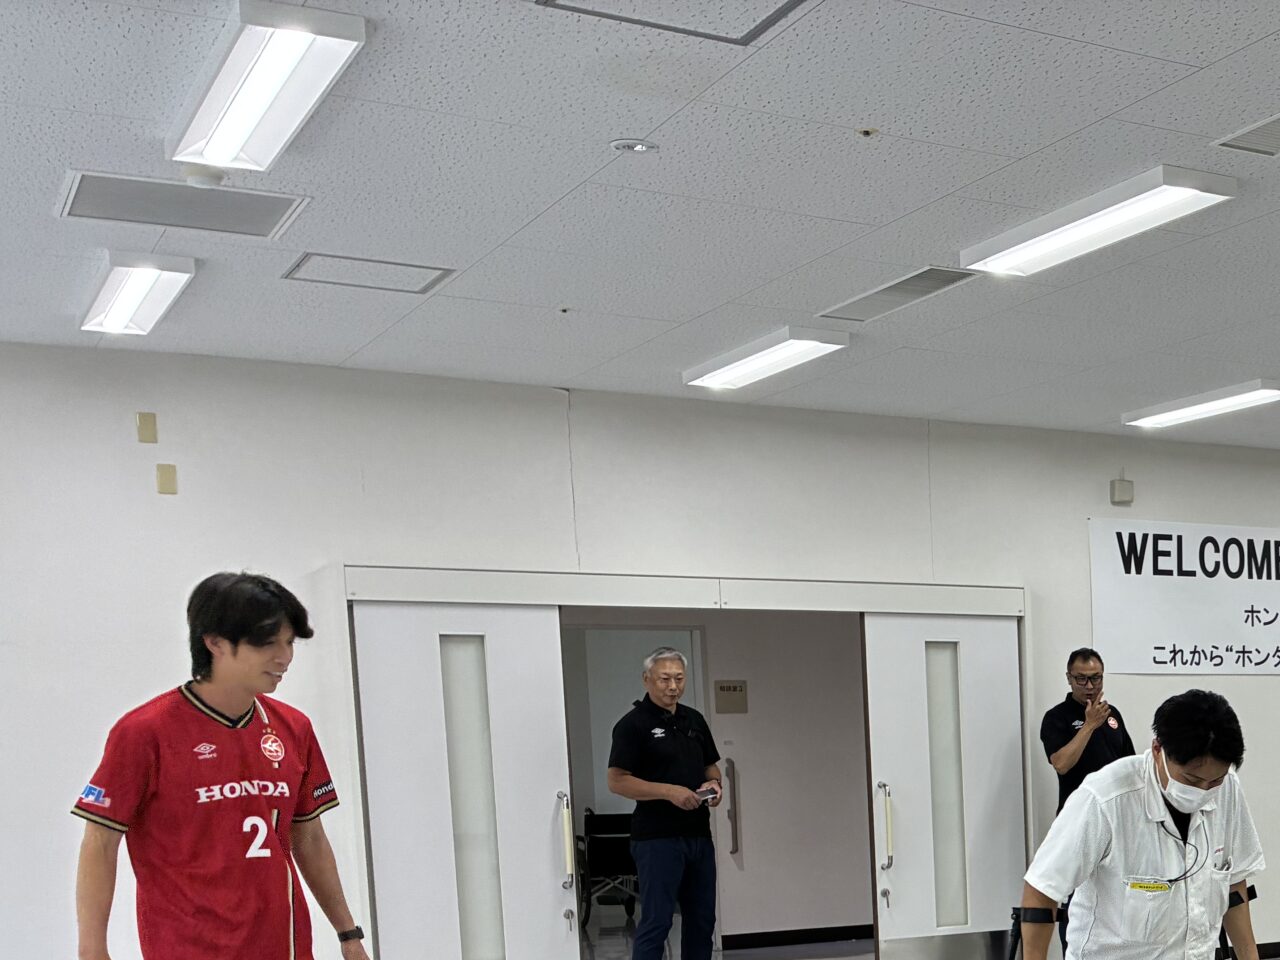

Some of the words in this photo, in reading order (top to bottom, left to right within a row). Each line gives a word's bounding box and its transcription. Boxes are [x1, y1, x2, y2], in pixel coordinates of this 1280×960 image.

[194, 779, 291, 804] HONDA
[313, 783, 334, 799] Hond
[242, 815, 272, 859] 2
